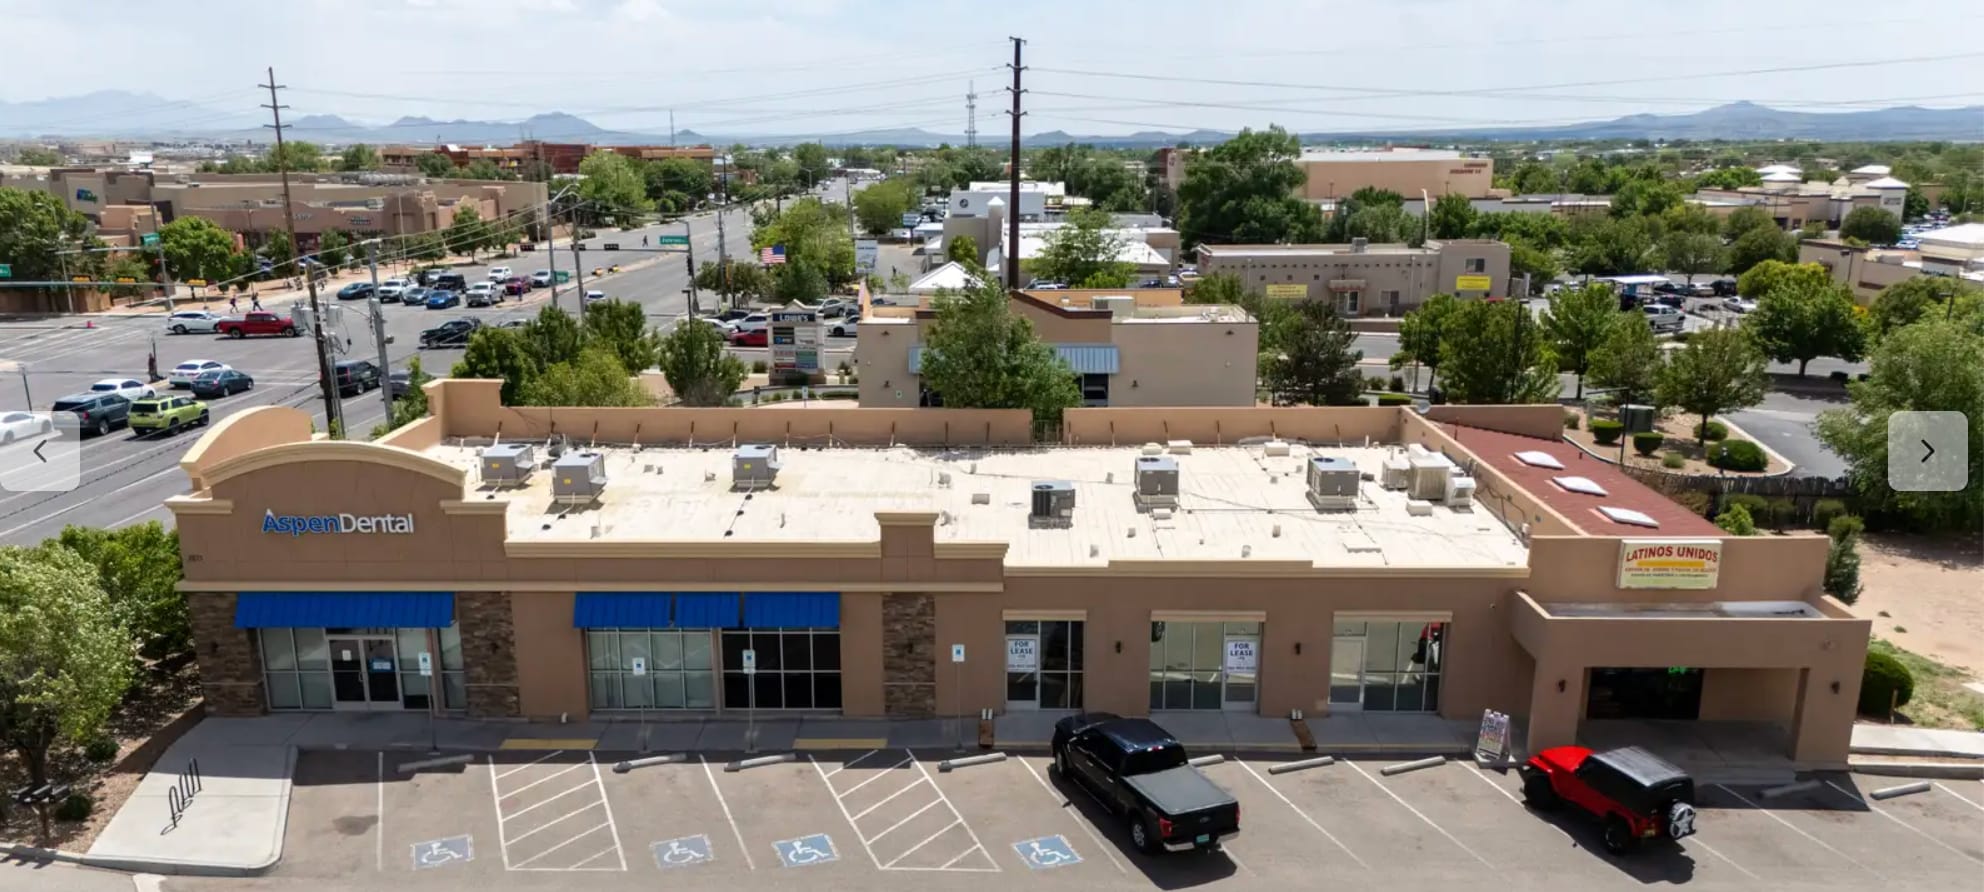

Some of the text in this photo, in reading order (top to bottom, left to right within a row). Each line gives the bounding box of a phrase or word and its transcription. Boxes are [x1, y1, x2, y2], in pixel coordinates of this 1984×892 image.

[262, 508, 415, 536] AspenDental
[1626, 546, 1718, 562] LATINOS UNIDOS
[1014, 640, 1029, 648] FOR
[1234, 642, 1250, 650] FOR
